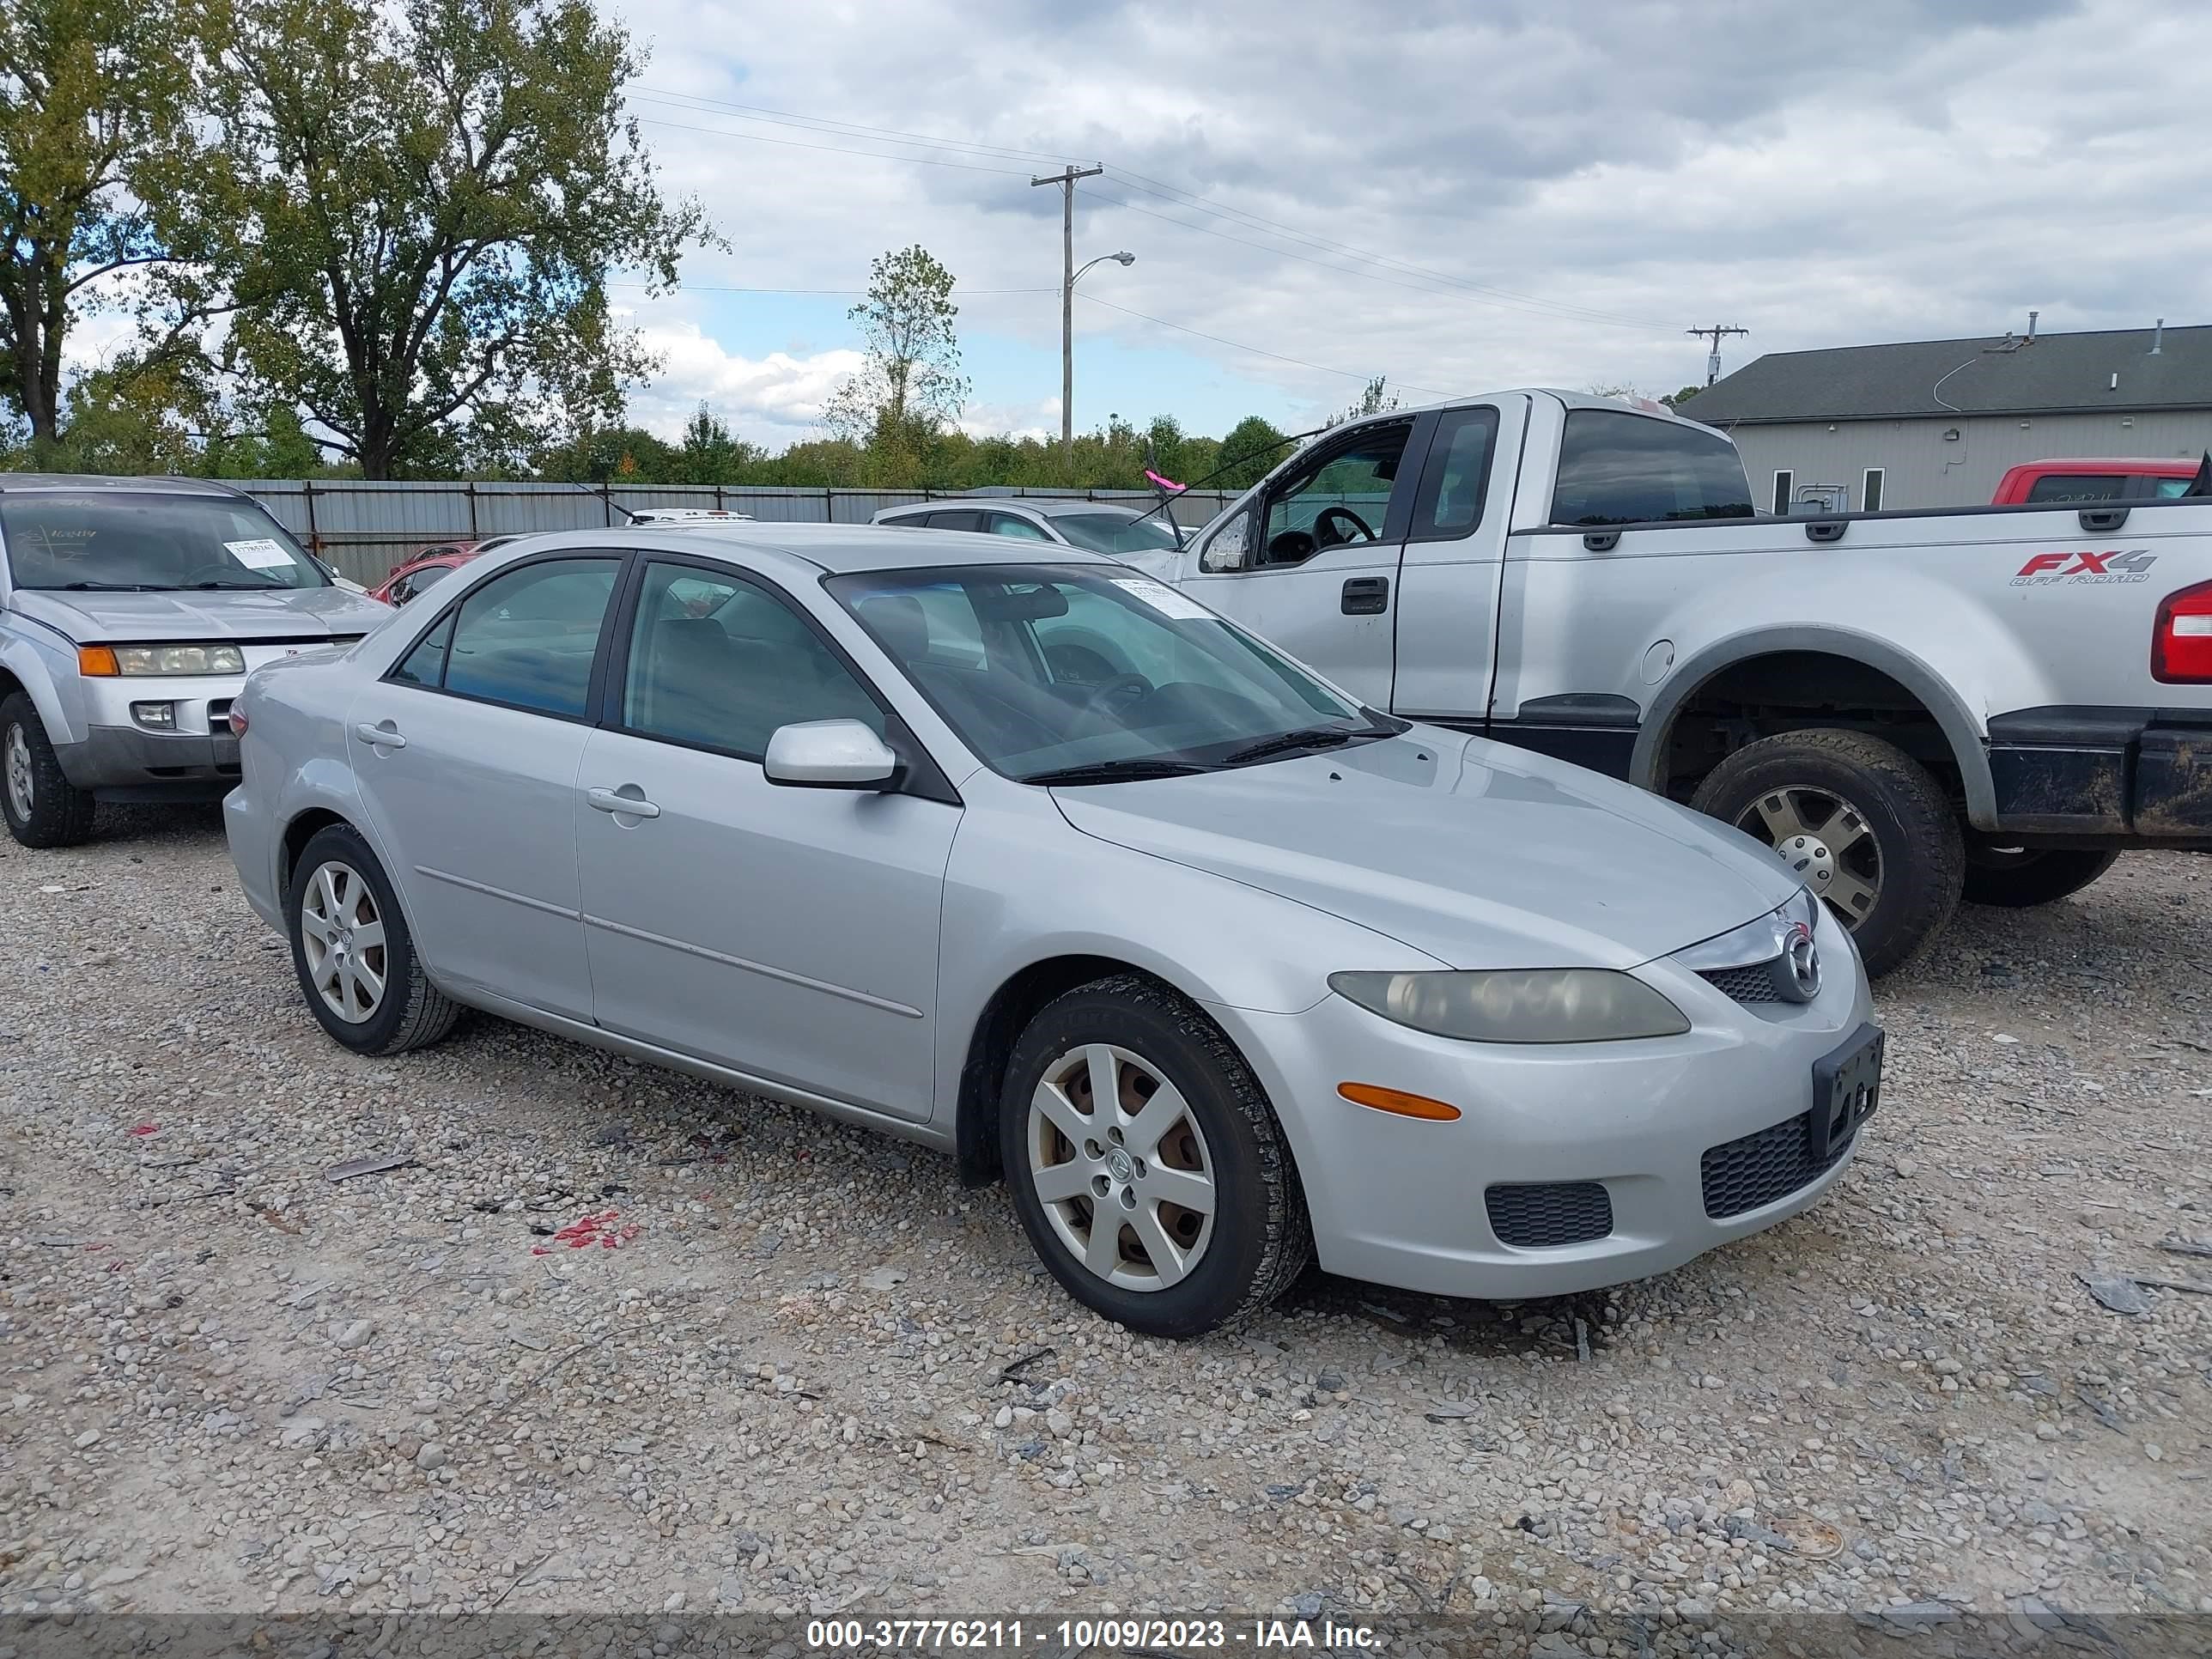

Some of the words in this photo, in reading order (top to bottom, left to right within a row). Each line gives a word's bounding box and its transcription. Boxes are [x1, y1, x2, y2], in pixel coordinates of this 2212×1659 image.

[2015, 550, 2159, 576] FX4
[2009, 575, 2063, 586] OFF
[2068, 574, 2150, 585] ROAD
